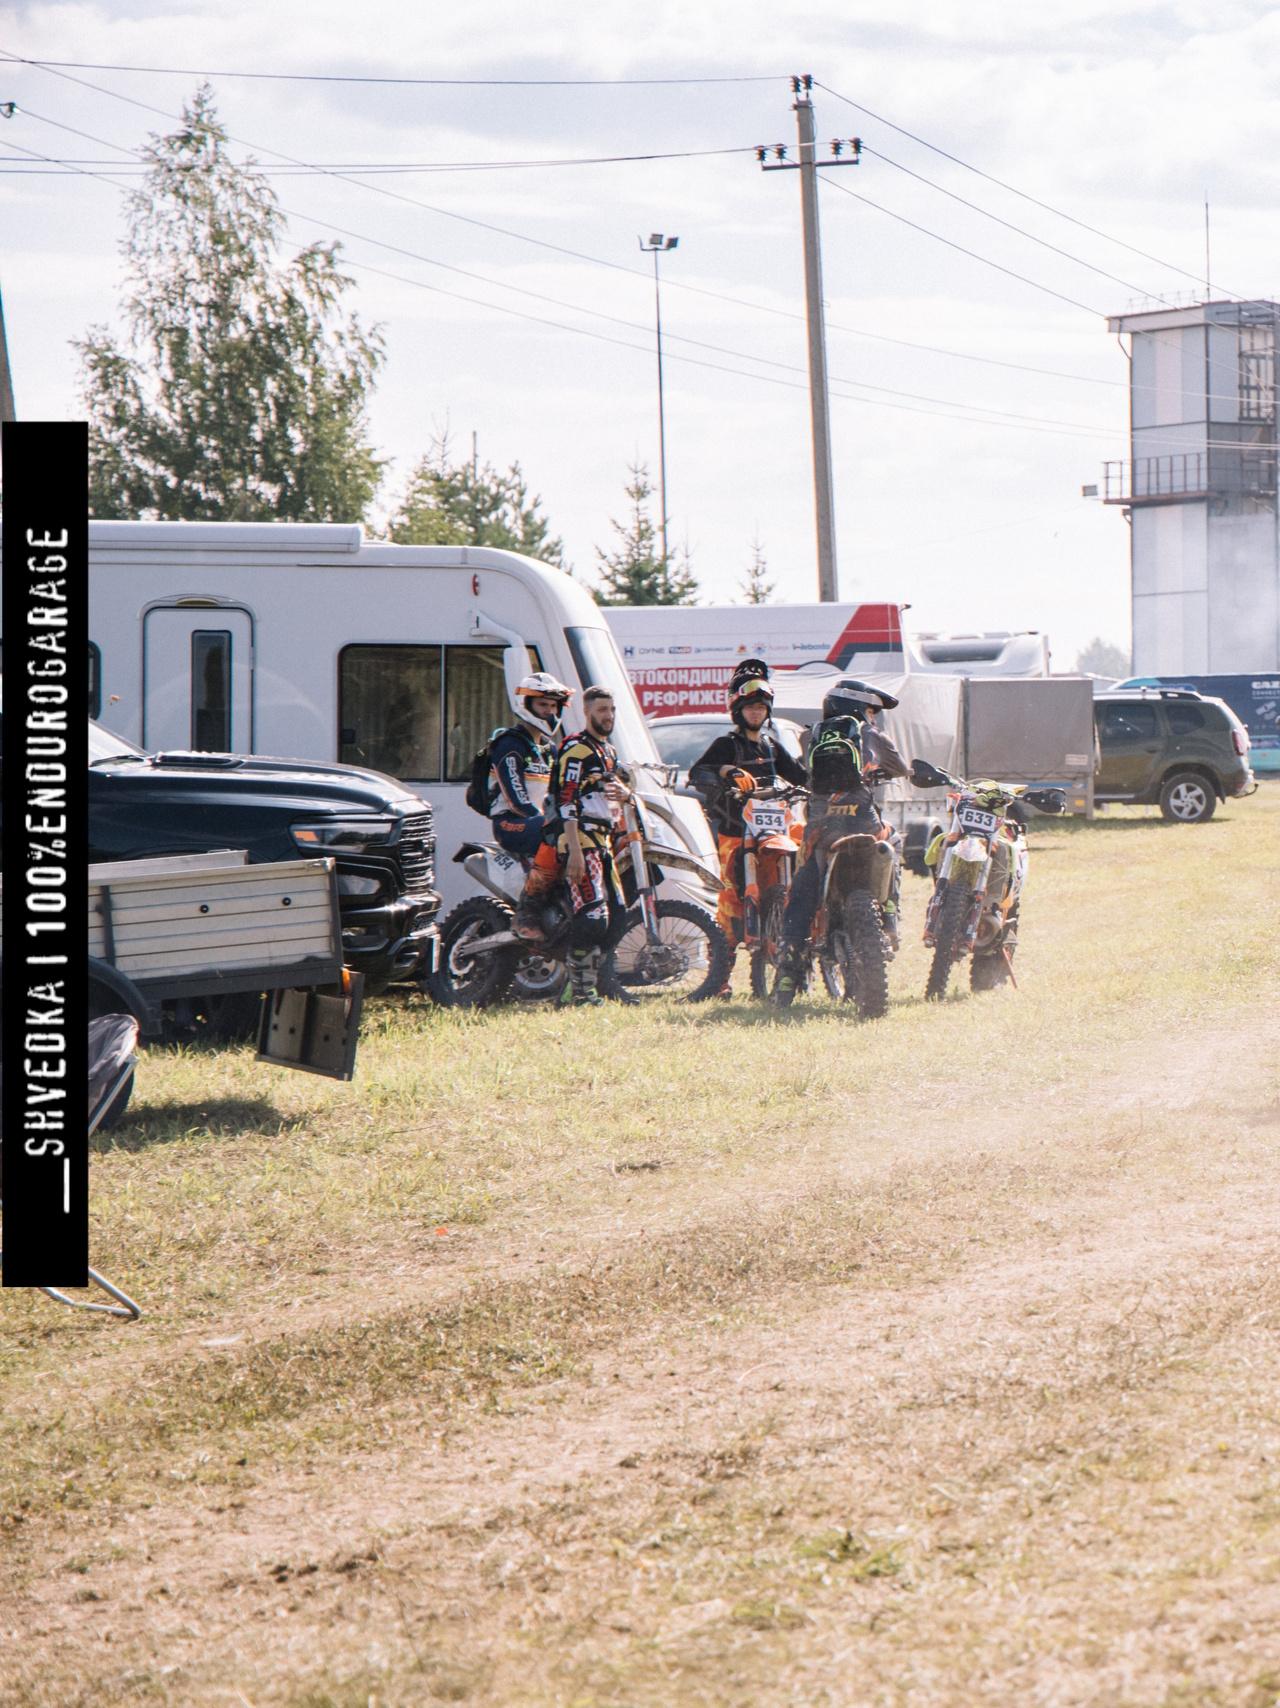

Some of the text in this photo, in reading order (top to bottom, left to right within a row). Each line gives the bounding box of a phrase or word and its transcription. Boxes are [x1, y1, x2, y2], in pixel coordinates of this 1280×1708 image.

[629, 668, 734, 687] ВТОКОНДИЦИ
[642, 689, 729, 706] РЕФРИЖЕ
[755, 814, 783, 827] 634
[964, 811, 994, 828] 633
[493, 852, 514, 871] 654
